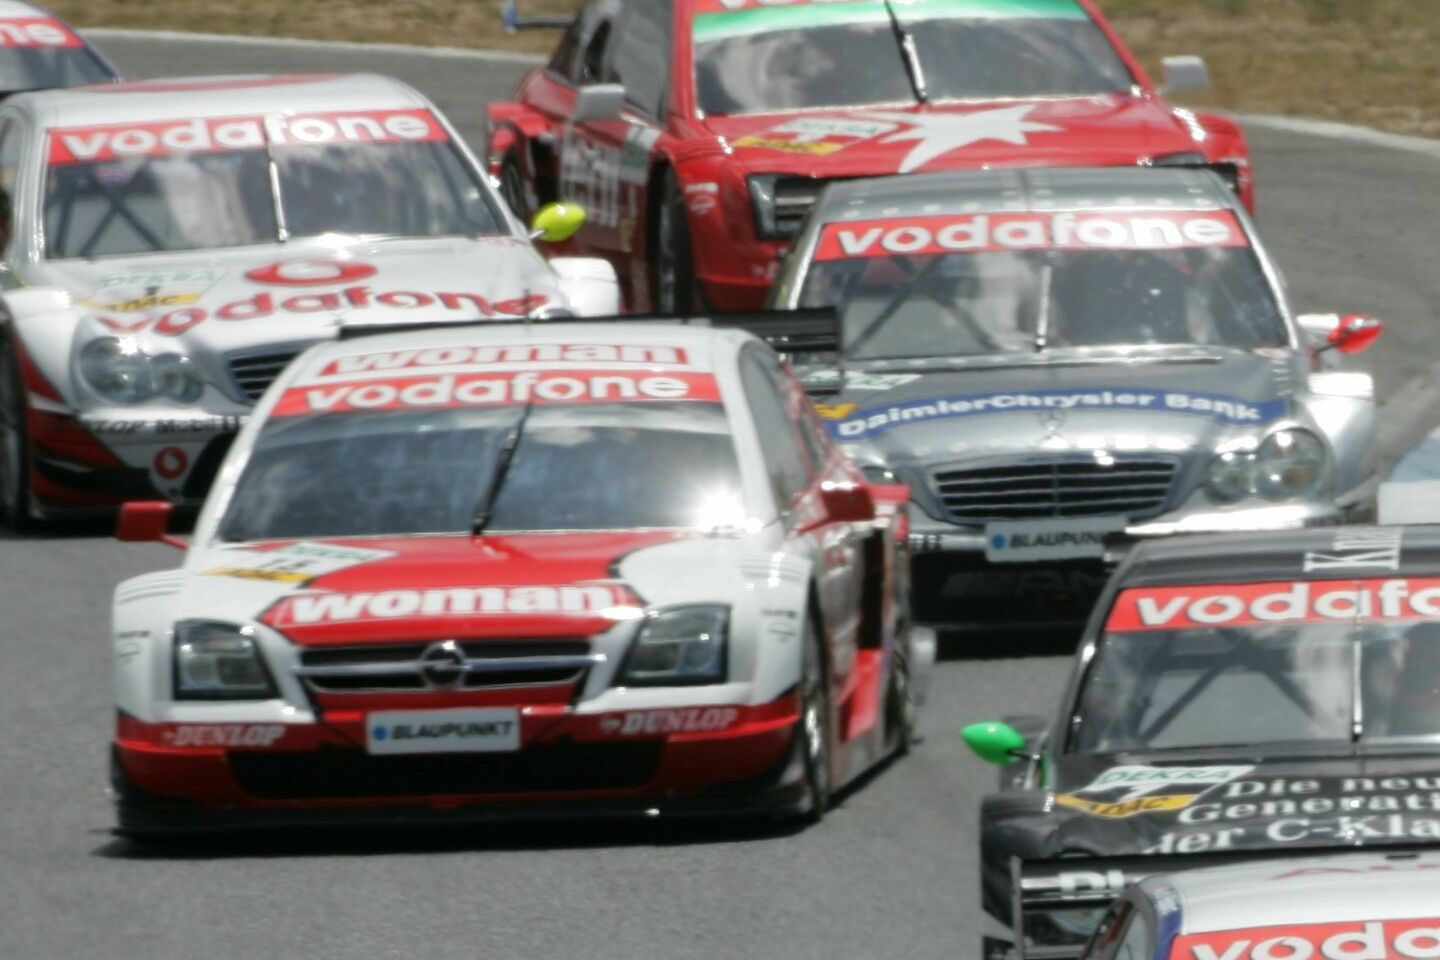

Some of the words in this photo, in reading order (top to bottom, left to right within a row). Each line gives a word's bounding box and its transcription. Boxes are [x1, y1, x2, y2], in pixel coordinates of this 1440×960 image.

[63, 110, 431, 159] vodafone
[837, 212, 1231, 256] vodafone
[97, 285, 551, 337] vodafone
[306, 372, 692, 412] vodafone
[837, 389, 1157, 437] DaimlerChrysler
[1165, 393, 1262, 422] Bank
[292, 585, 617, 624] woman
[173, 725, 285, 747] DUNLOP
[392, 721, 513, 741] BLAUPUNKT
[619, 708, 738, 735] DUNLOP
[1224, 778, 1321, 798] Die
